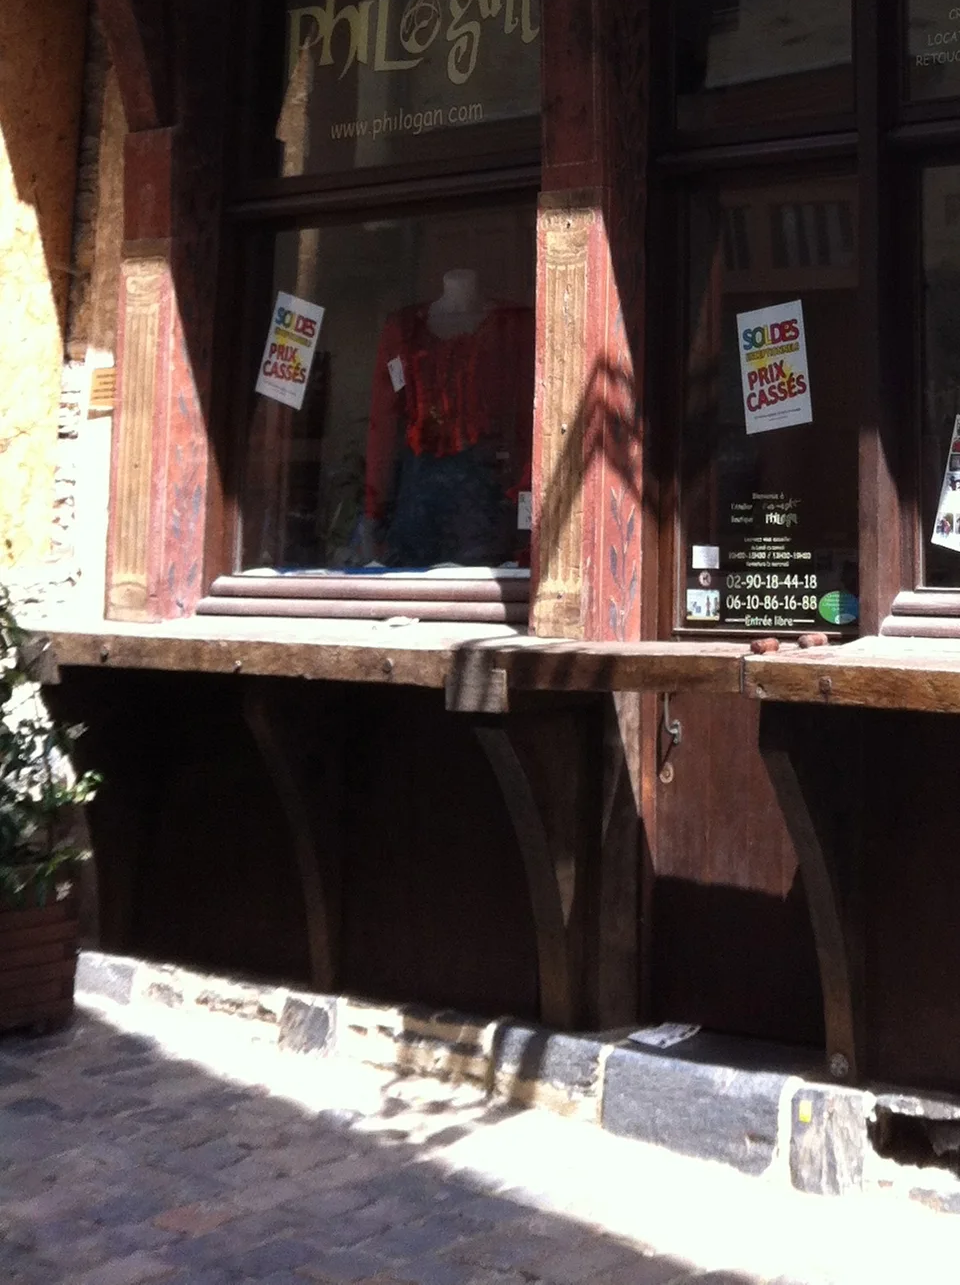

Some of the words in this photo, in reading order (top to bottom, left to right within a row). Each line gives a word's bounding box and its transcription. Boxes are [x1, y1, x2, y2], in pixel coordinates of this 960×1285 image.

[330, 103, 483, 140] www.philogan.com
[275, 306, 317, 339] SOLDES
[743, 319, 800, 351] SOLDES
[268, 342, 299, 363] PRIX
[747, 359, 787, 391] PRIX
[746, 372, 807, 412] CASSÉS
[726, 574, 818, 589] 02-90-18-44-18
[726, 595, 818, 610] 06-10-86-16-88
[744, 614, 773, 627] Entrée
[774, 615, 793, 626] libre
